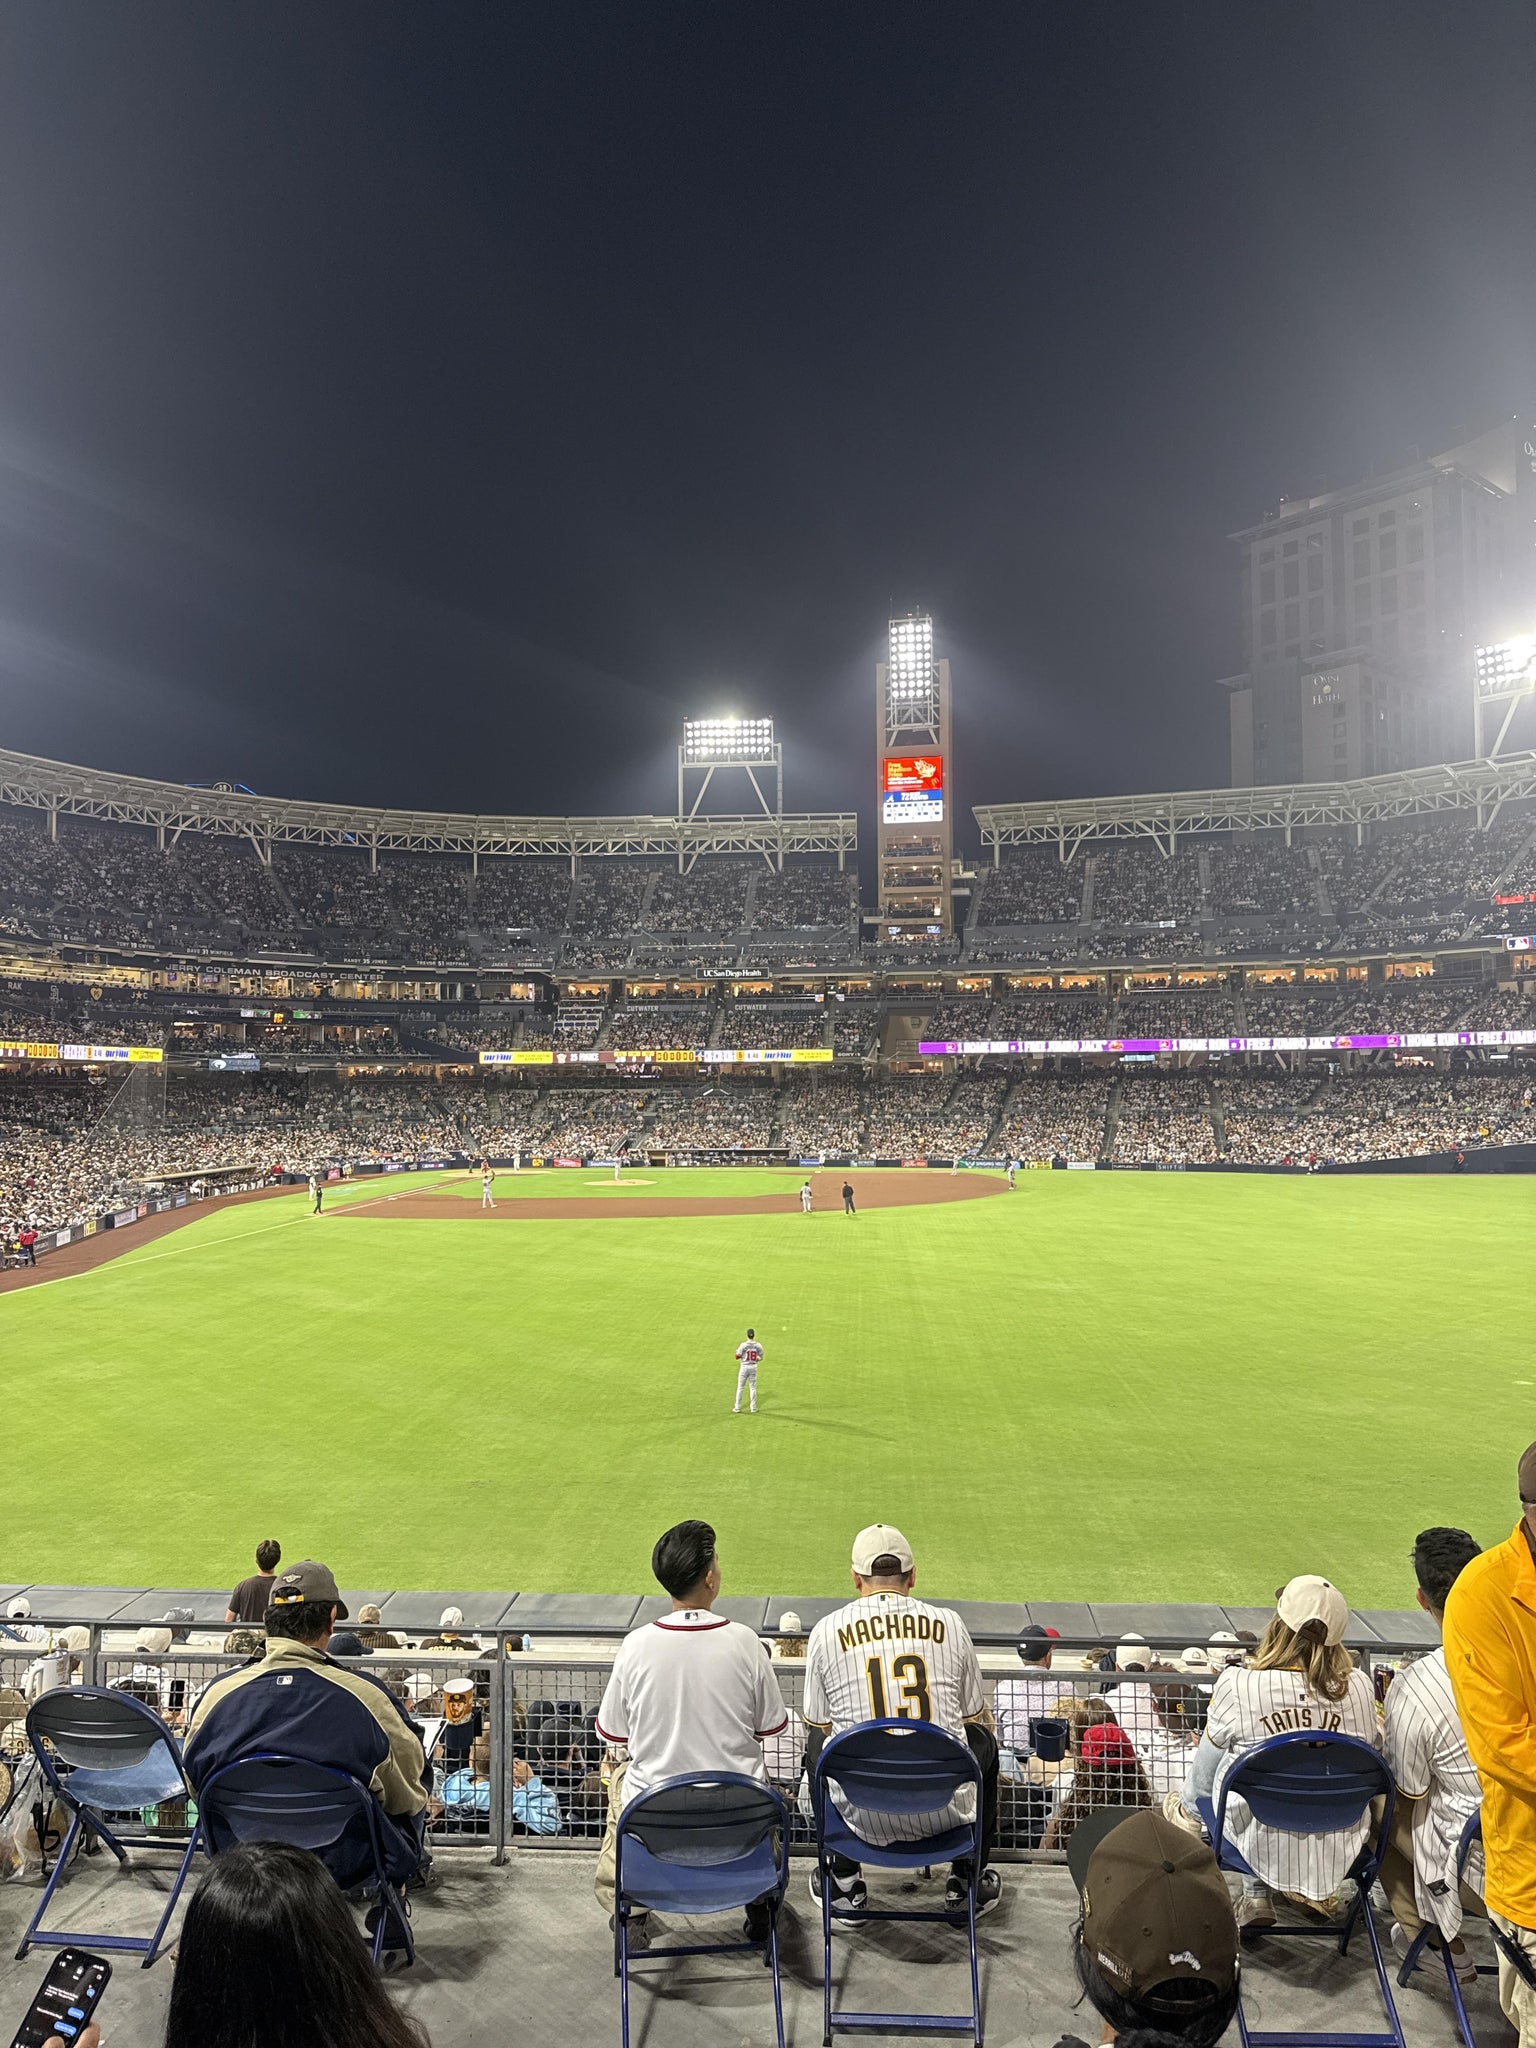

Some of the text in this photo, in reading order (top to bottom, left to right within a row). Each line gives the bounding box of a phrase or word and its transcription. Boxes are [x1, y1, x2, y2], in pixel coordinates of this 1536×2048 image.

[165, 963, 384, 981] JERRY COLEMAN BROADCAST CENTER
[703, 969, 762, 978] UC San Diego Health
[7, 982, 22, 990] RAK
[1477, 1031, 1502, 1045] FREE
[837, 1613, 946, 1653] MACHADO
[866, 1653, 932, 1722] 13
[1259, 1708, 1342, 1735] TATIS JR
